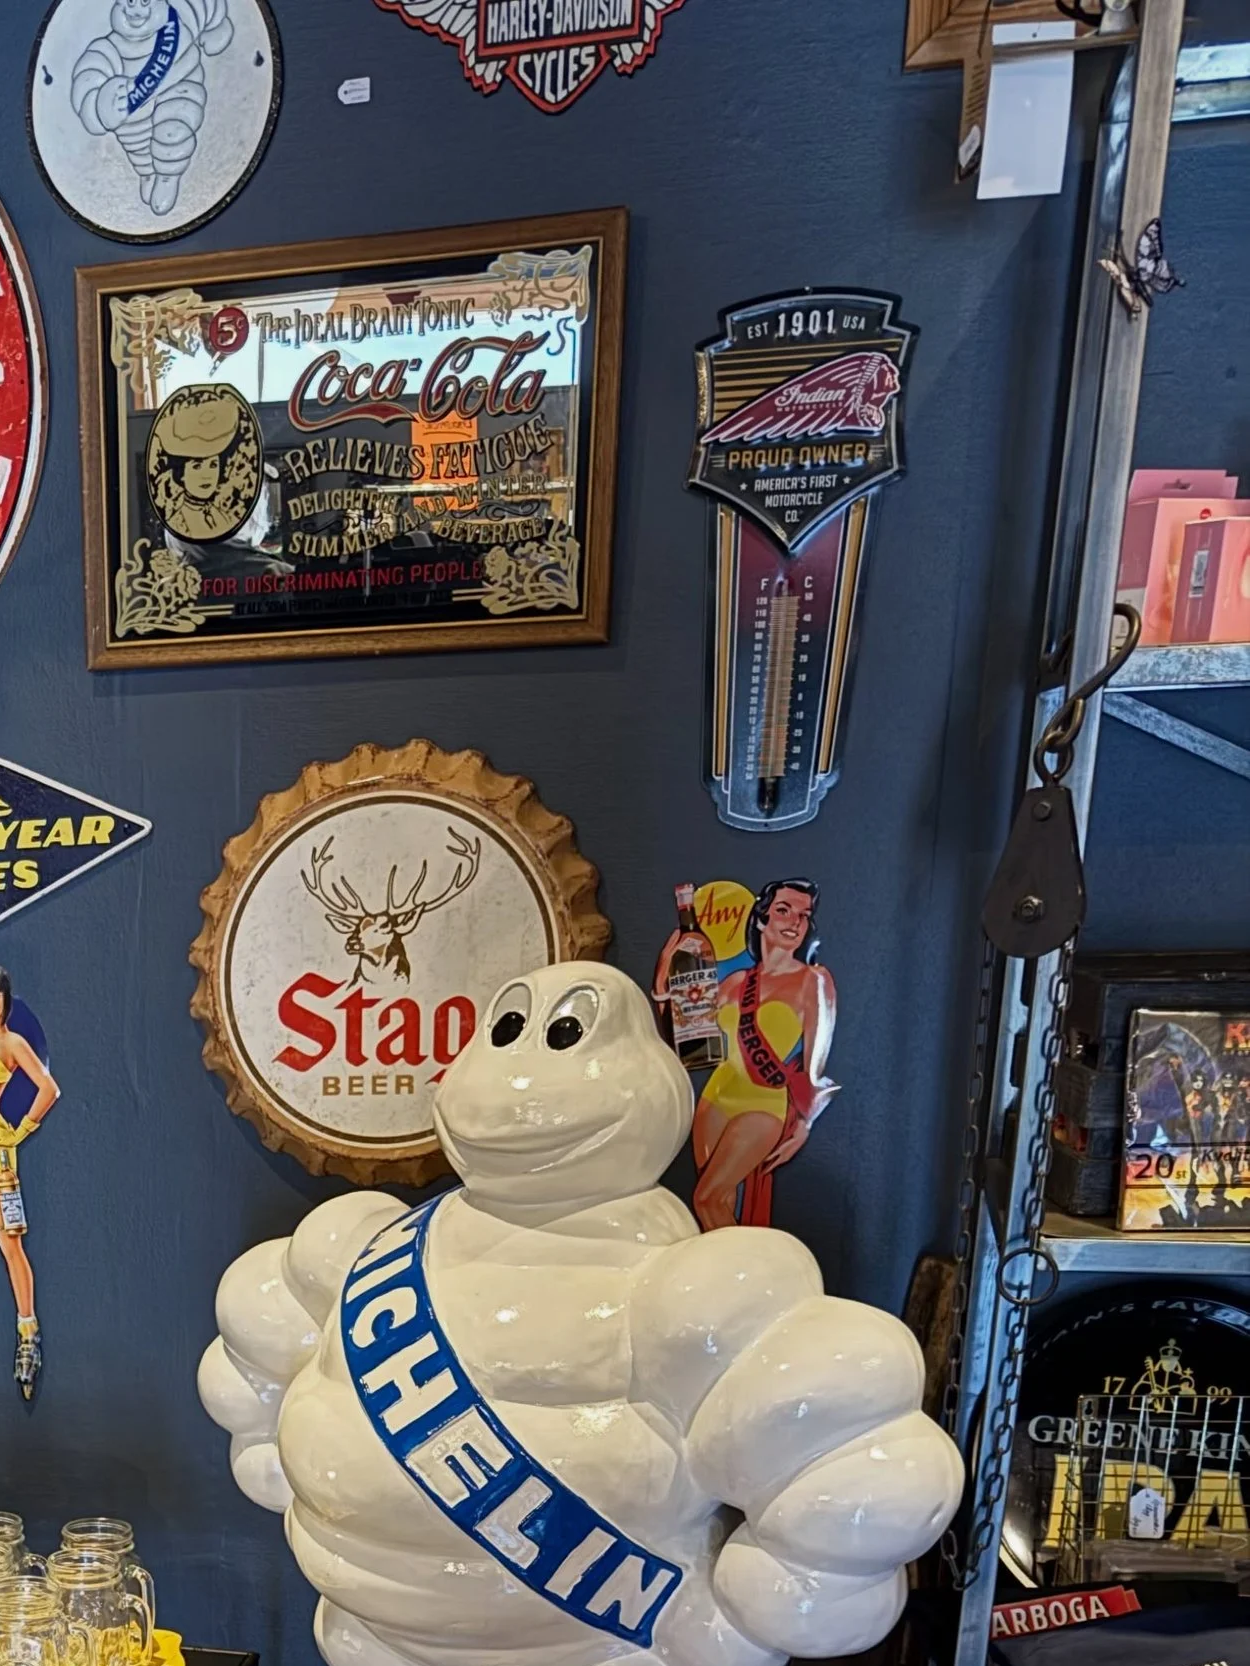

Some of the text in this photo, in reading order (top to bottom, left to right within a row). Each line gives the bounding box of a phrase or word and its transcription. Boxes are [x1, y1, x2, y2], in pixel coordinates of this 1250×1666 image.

[487, 0, 634, 45] HARLEY-DAVIDSON
[129, 20, 176, 105] MICHELIN
[517, 45, 596, 104] CYCLES
[254, 297, 476, 348] THE IDEAL BRAIN TONIC
[747, 308, 866, 340] EST 1901 USA
[288, 330, 552, 433] Coca-Cola
[774, 383, 846, 408] Indian
[283, 413, 554, 484] RELIEVES FATIGUE
[728, 443, 871, 469] PROUD OWNER
[754, 475, 838, 492] AMERICA'S FIRST
[765, 492, 824, 508] MOTORCYCLE
[287, 487, 403, 521] DELIGHTFUL
[288, 472, 550, 557] SUMMER AND WINTER
[436, 517, 547, 545] BEVERAGE
[203, 560, 483, 598] FOR DISCRIMINATING PEOPLE
[761, 576, 813, 591] F C
[697, 887, 746, 943] Any
[670, 971, 705, 987] BERGER
[738, 1012, 787, 1087] BERGER
[322, 1074, 415, 1097] BEER
[1134, 1153, 1175, 1179] 20
[1103, 1376, 1127, 1395] 17
[346, 1200, 675, 1632] MICHELIN
[1028, 1414, 1180, 1454] GREENE
[1041, 1453, 1250, 1549] IPA
[991, 1595, 1111, 1639] ARBOGA
